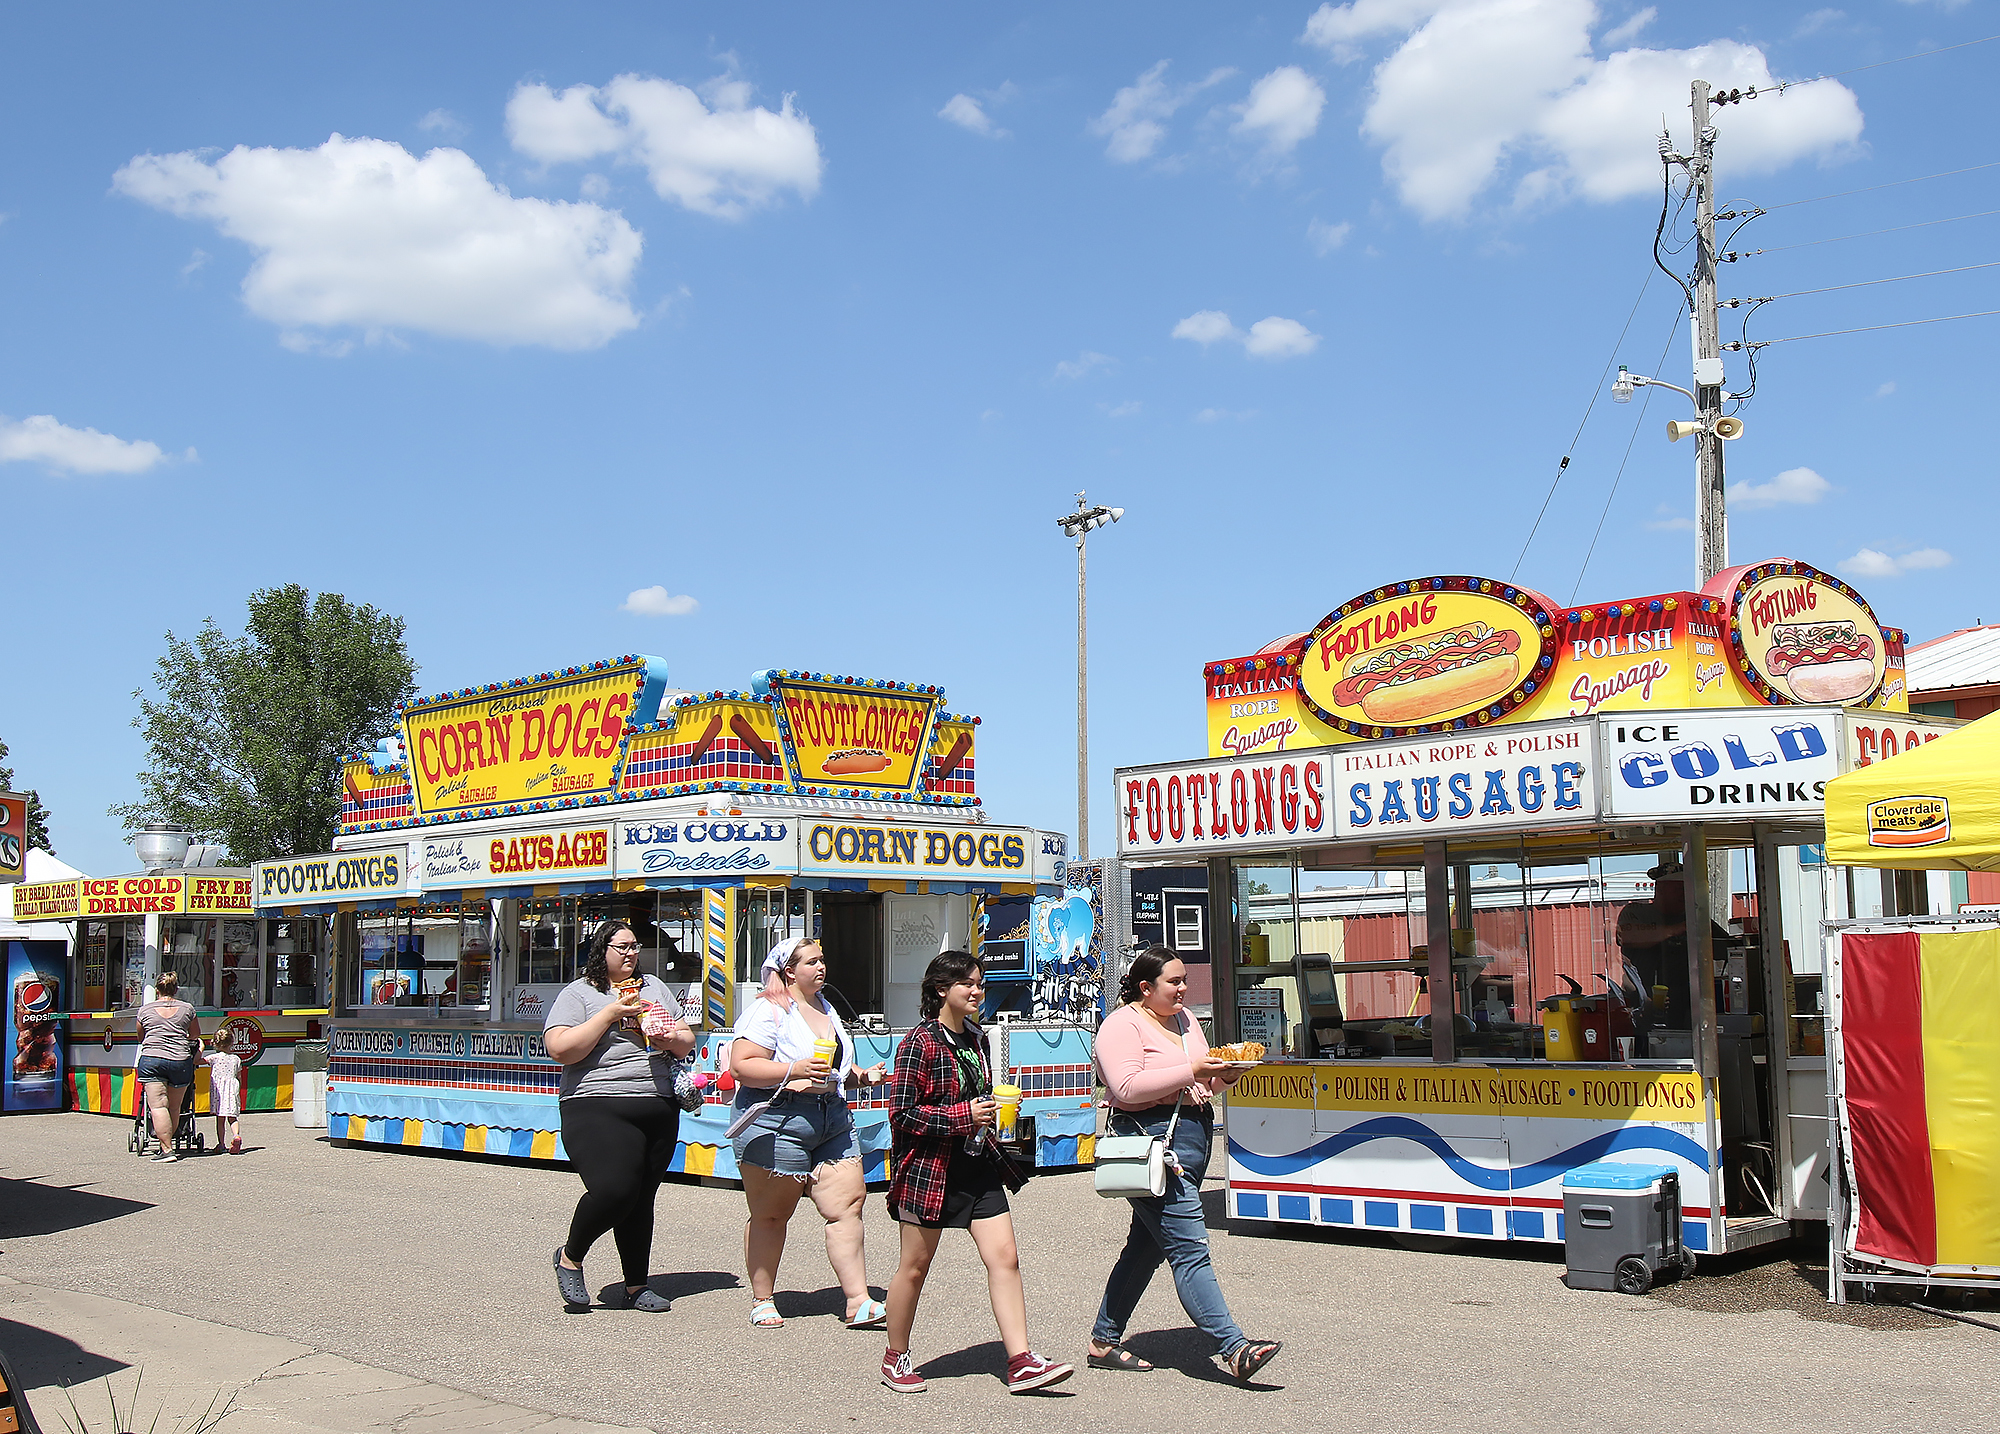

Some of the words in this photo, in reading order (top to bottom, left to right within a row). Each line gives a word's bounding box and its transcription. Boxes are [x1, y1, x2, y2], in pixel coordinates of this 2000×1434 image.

[1749, 580, 1817, 636] FOOTLONG
[1320, 593, 1438, 672] FOOTLONG
[1687, 621, 1719, 638] ITALIAN
[1572, 627, 1674, 662] POLISH
[1695, 641, 1715, 656] ROPE
[1213, 674, 1295, 700] ITALIAN
[1568, 658, 1670, 717] Sausage
[488, 692, 548, 717] Colossal
[1230, 699, 1279, 718] ROPE
[418, 713, 513, 786] CORN
[519, 692, 628, 763] DOGS
[785, 697, 924, 757] FOOTLONGS
[1221, 717, 1299, 756] Sausage
[1617, 725, 1680, 744] ICE
[1345, 749, 1421, 772] ITALIAN
[1429, 743, 1476, 763] ROPE
[1484, 741, 1498, 757] &
[1507, 732, 1581, 755] POLISH
[1618, 721, 1828, 789] COLD
[549, 764, 568, 781] Rope
[551, 773, 594, 793] SAUSAGE
[434, 775, 468, 805] Polish
[458, 785, 497, 805] SAUSAGE
[1126, 760, 1325, 845] FOOTLONGS
[1349, 761, 1583, 828] SAUSAGE
[1690, 780, 1826, 807] DRINKS
[1874, 802, 1941, 817] Cloverdale
[1878, 816, 1916, 827] meats
[624, 822, 678, 845] ICE
[683, 820, 788, 843] COLD
[425, 842, 455, 861] Polish
[456, 840, 463, 856] &
[489, 830, 609, 875] SAUSAGE
[807, 823, 919, 866] CORN
[923, 830, 1026, 870] DOGS
[427, 861, 458, 878] Italian
[458, 856, 481, 875] Rope
[641, 847, 770, 873] Drinks
[83, 879, 118, 896] ICE
[123, 878, 182, 896] COLD
[196, 880, 229, 894] FRY
[262, 854, 399, 897] FOOTLONGS
[15, 887, 27, 902] FRY
[28, 885, 51, 901] BREAD
[51, 882, 76, 899] TACOS
[88, 896, 175, 913] DRINKS
[190, 896, 214, 908] FRY
[22, 1013, 50, 1024] pepsi
[334, 1030, 364, 1052] CORN
[364, 1032, 394, 1053] DOGS
[409, 1032, 452, 1055] POLISH
[451, 1034, 465, 1057] &
[470, 1033, 524, 1059] ITALIAN
[1335, 1076, 1390, 1101] POLISH
[1396, 1077, 1407, 1101] &
[1413, 1078, 1481, 1103] ITALIAN
[1489, 1080, 1561, 1105] SAUSAGE
[1582, 1081, 1696, 1109] FOOTLONGS
